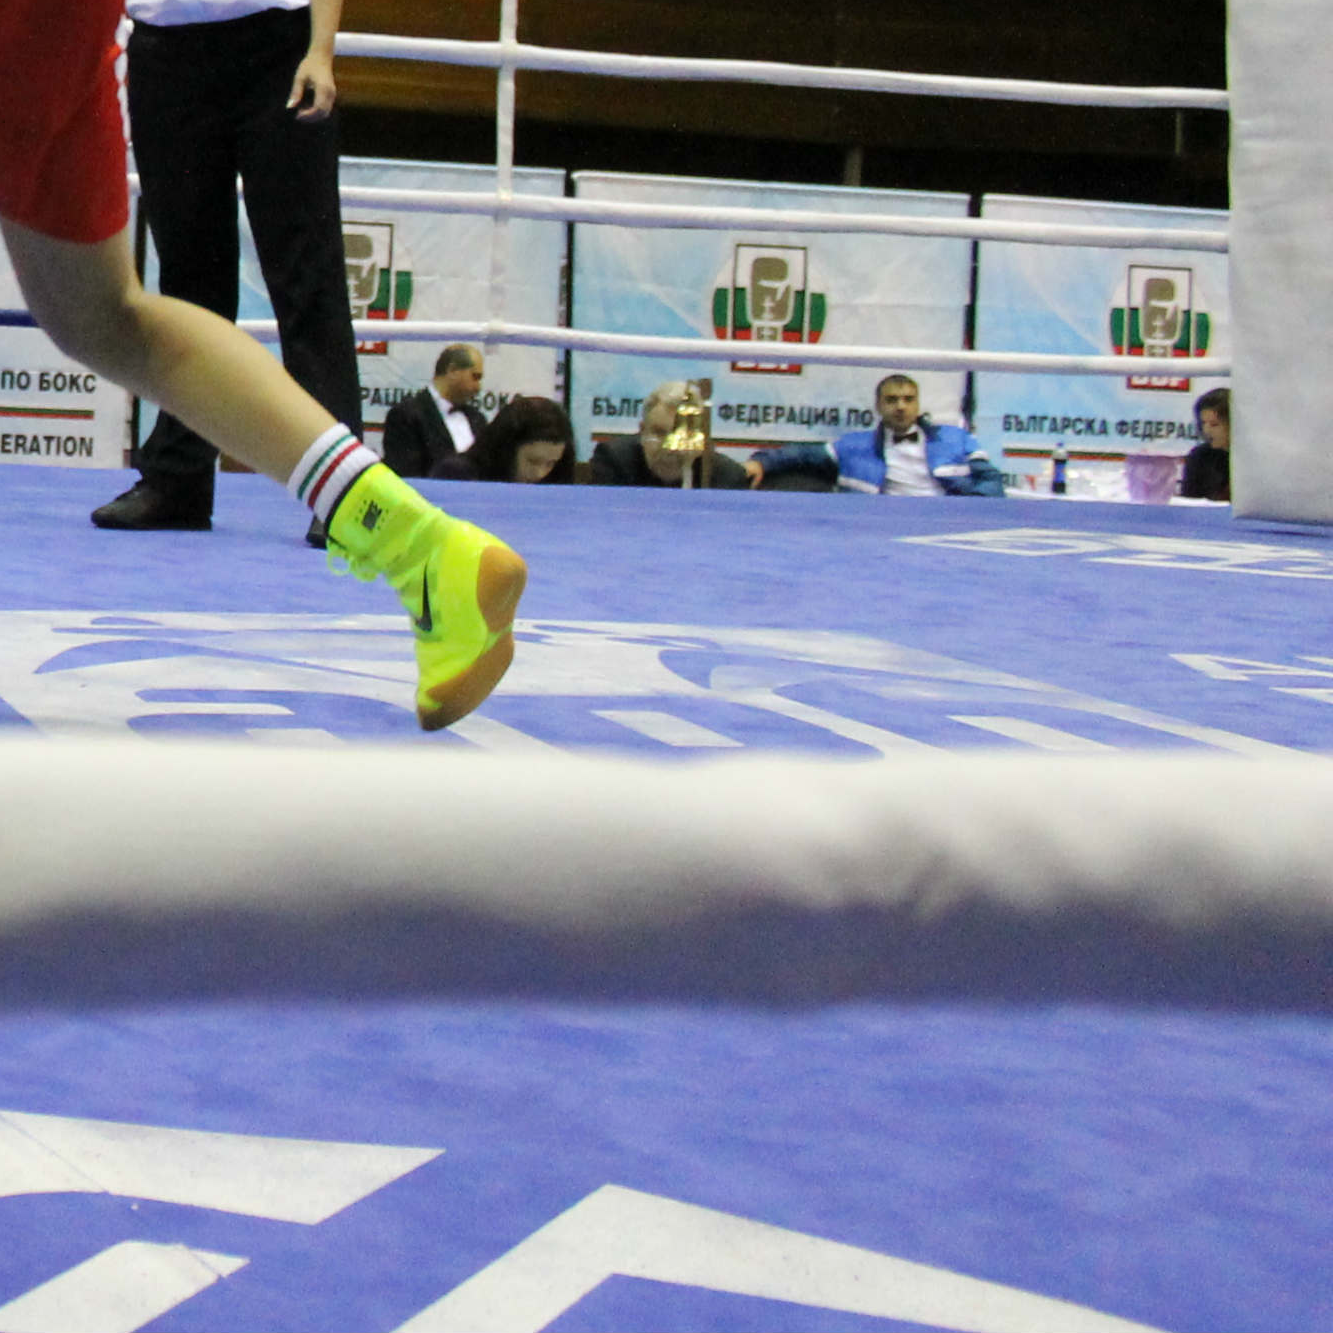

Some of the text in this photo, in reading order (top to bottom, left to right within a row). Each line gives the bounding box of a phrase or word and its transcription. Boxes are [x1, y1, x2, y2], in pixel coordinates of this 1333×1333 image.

[0, 369, 32, 392] ПО
[38, 371, 97, 394] БОКС
[717, 402, 840, 429] ФЕДЕРАЦИЯ
[846, 409, 875, 428] ПО
[1002, 414, 1109, 437] БЪЛГАРСКА
